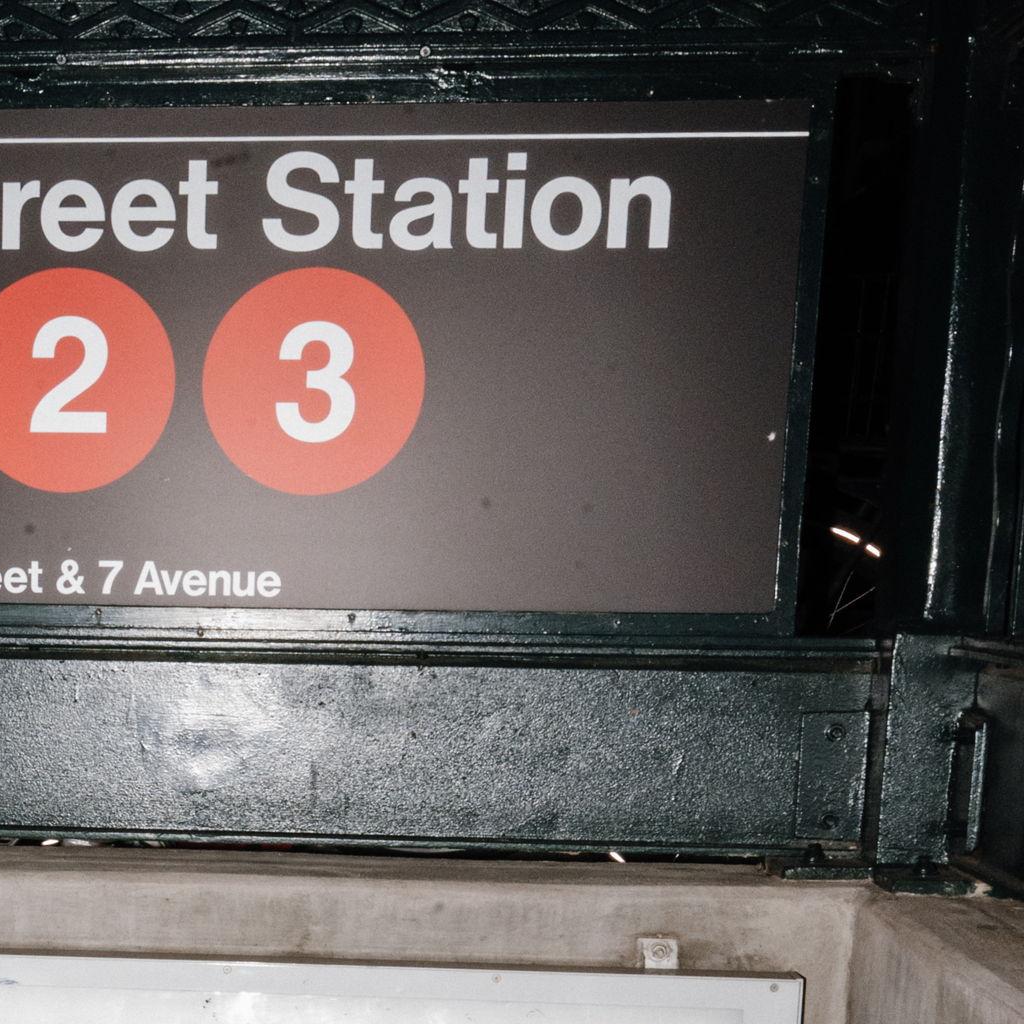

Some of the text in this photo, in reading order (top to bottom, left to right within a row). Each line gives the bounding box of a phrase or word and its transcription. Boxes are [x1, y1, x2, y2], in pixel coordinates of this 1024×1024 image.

[262, 151, 671, 251] Station
[30, 316, 108, 434] 2
[275, 321, 356, 443] 3
[56, 559, 86, 596] &
[97, 559, 126, 595] 7
[134, 561, 283, 598] Avenue
